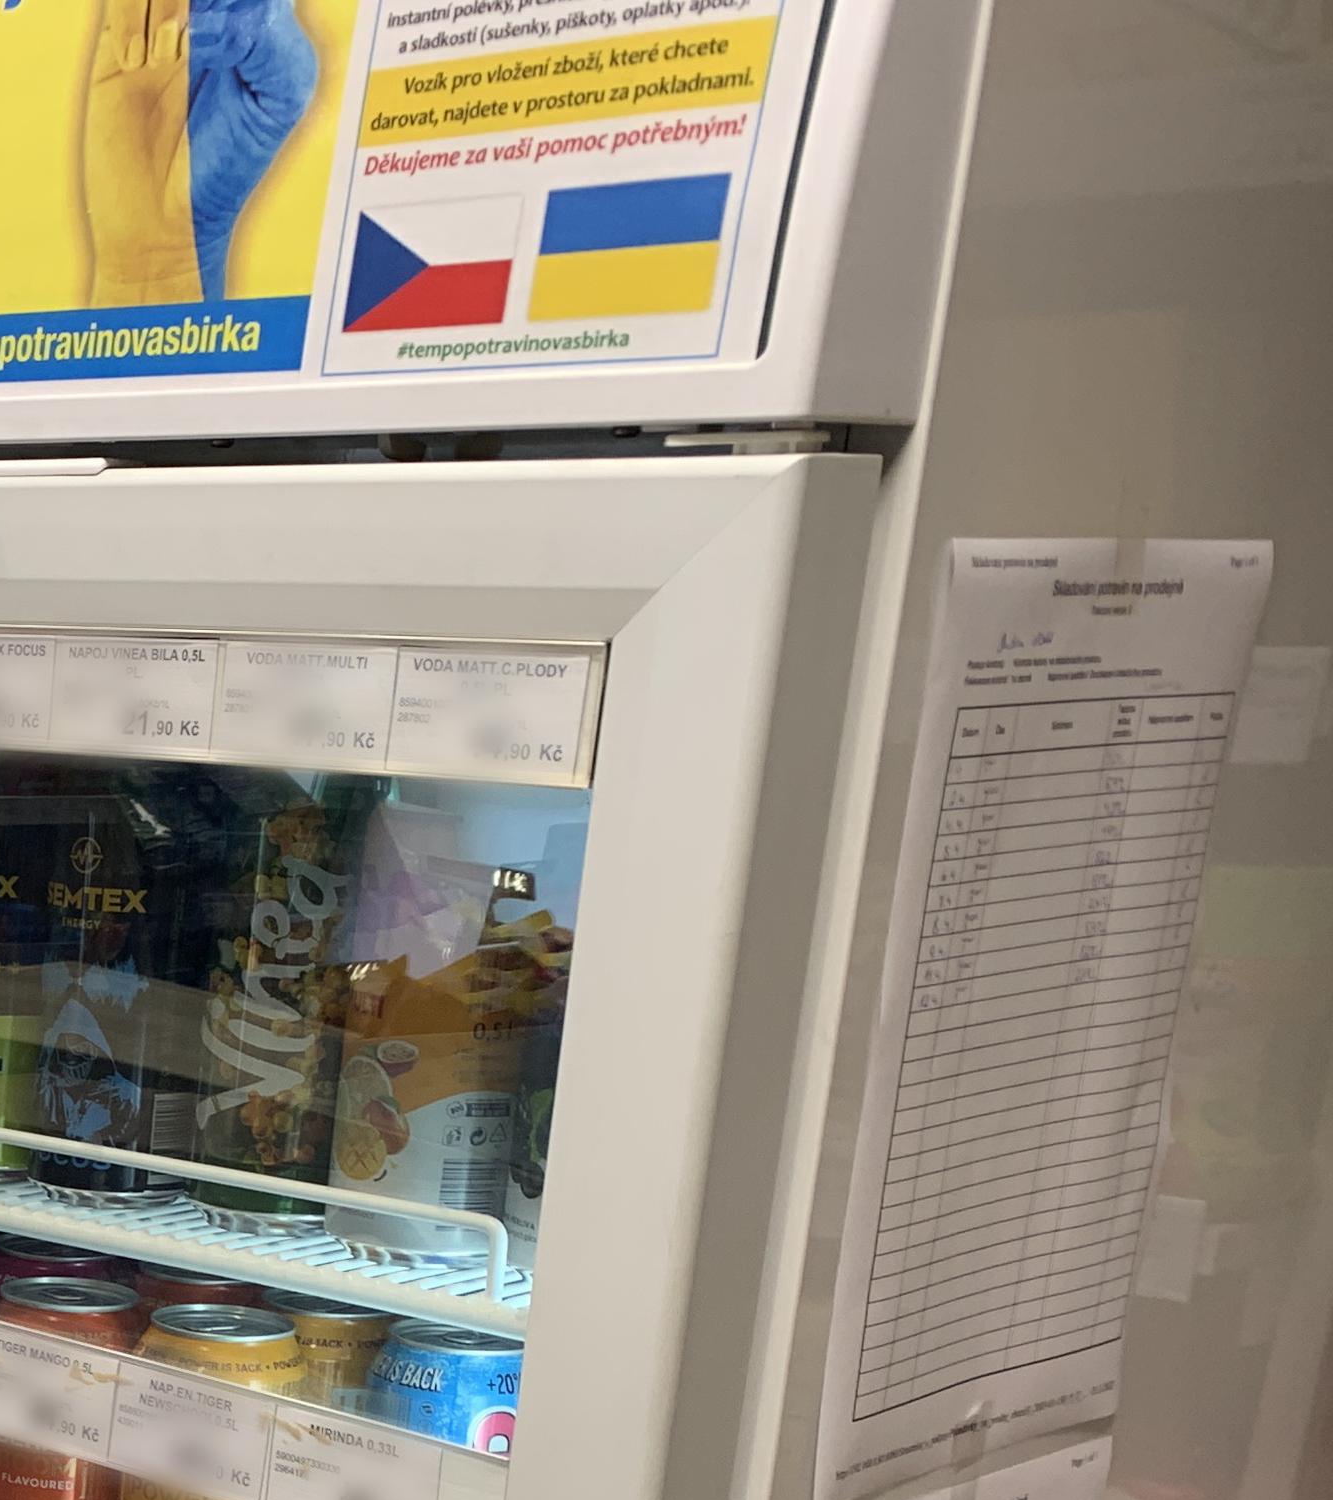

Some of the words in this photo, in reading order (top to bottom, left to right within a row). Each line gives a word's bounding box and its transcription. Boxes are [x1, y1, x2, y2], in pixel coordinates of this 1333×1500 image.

[398, 40, 408, 54] a
[410, 27, 478, 51] sladkosti
[404, 73, 448, 96] Vozík
[452, 69, 483, 92] pro
[486, 56, 549, 85] vložení
[551, 50, 604, 78] zboží,
[608, 43, 660, 68] které
[663, 35, 729, 61] chcete
[370, 108, 438, 132] darovat,
[442, 98, 509, 127] najdete
[512, 101, 523, 116] v
[526, 87, 605, 114] prostoru
[608, 85, 630, 104] za
[633, 66, 755, 101] pokladnami.
[363, 148, 461, 177] Děkujeme
[465, 147, 488, 167] za
[492, 136, 531, 164] vaši
[534, 134, 606, 164] pomoc
[611, 113, 746, 150] potřebným!
[397, 328, 630, 361] #tempopotravinovasbirka
[6, 643, 47, 659] FOCUS
[67, 645, 108, 662] NAPOJ
[109, 647, 149, 663] VINEA
[150, 648, 179, 663] BILA
[180, 648, 206, 664] 0,5L
[246, 648, 283, 668] VODA
[412, 655, 454, 675] VODA
[180, 715, 201, 738] Kč
[353, 730, 375, 751] Kč
[538, 742, 563, 762] Kč
[46, 881, 148, 915] SEMTEX
[29, 1346, 71, 1369] MANGO
[402, 1362, 445, 1393] BACK
[196, 1393, 233, 1413] TIGER
[81, 1426, 100, 1443] Kč
[309, 1423, 365, 1449] MIRINDA
[366, 1439, 400, 1458] 0,33L
[1, 1471, 74, 1491] FLAVOURED
[231, 1469, 251, 1488] Kč
